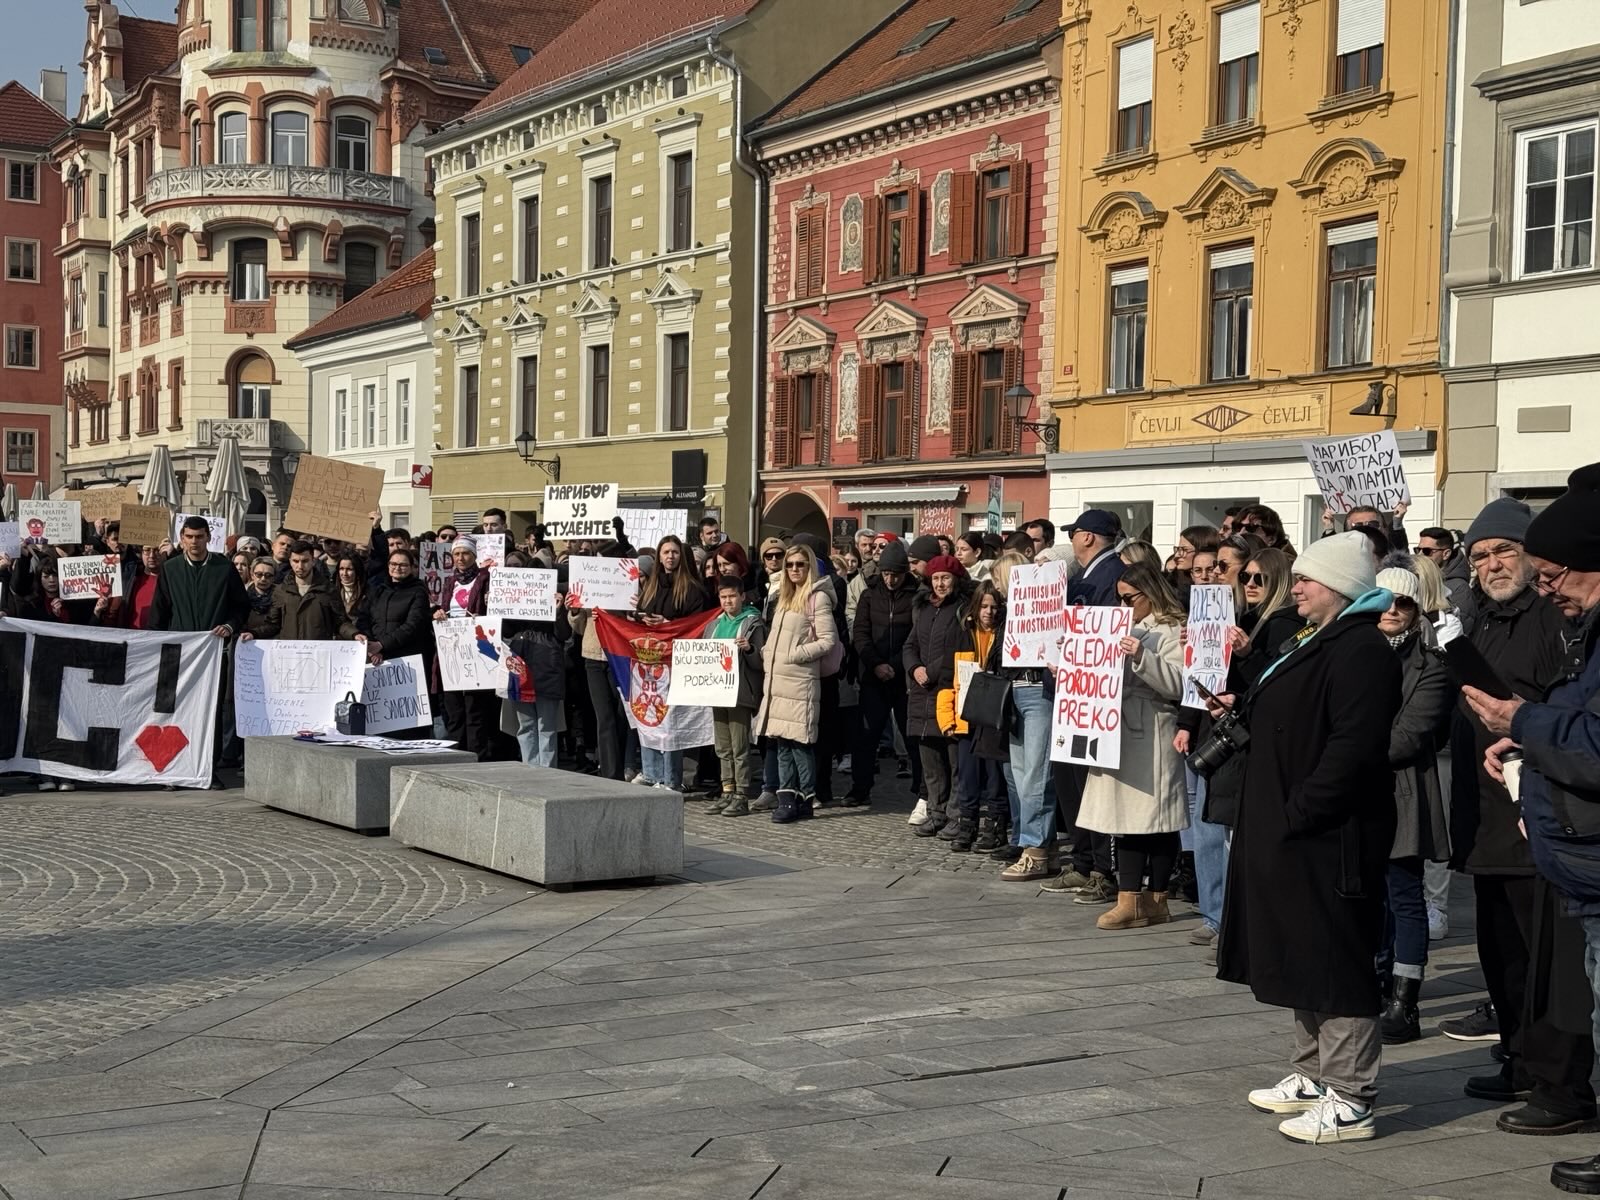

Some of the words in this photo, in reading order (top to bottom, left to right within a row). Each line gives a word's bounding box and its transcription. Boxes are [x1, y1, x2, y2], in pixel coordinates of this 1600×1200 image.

[1139, 416, 1182, 434] ČEVLJI
[1263, 405, 1312, 425] ČEVLJI
[1312, 434, 1382, 459] МАРИБОР
[1358, 449, 1394, 470] ТАРУ
[1357, 464, 1405, 491] ПАМТИ
[548, 484, 610, 500] МАРИБОР
[571, 503, 587, 518] УЗ
[544, 520, 611, 536] СТУДЕНТЕ
[1008, 619, 1014, 634] U
[1064, 606, 1104, 635] NEĆU
[1110, 608, 1131, 636] DA
[674, 641, 691, 652] KAD
[1063, 638, 1126, 670] GLEDAM
[1056, 668, 1120, 699] PORODICU
[367, 689, 381, 702] UZ
[384, 694, 429, 720] ŠAMPIONE
[1058, 698, 1119, 732] PREKO
